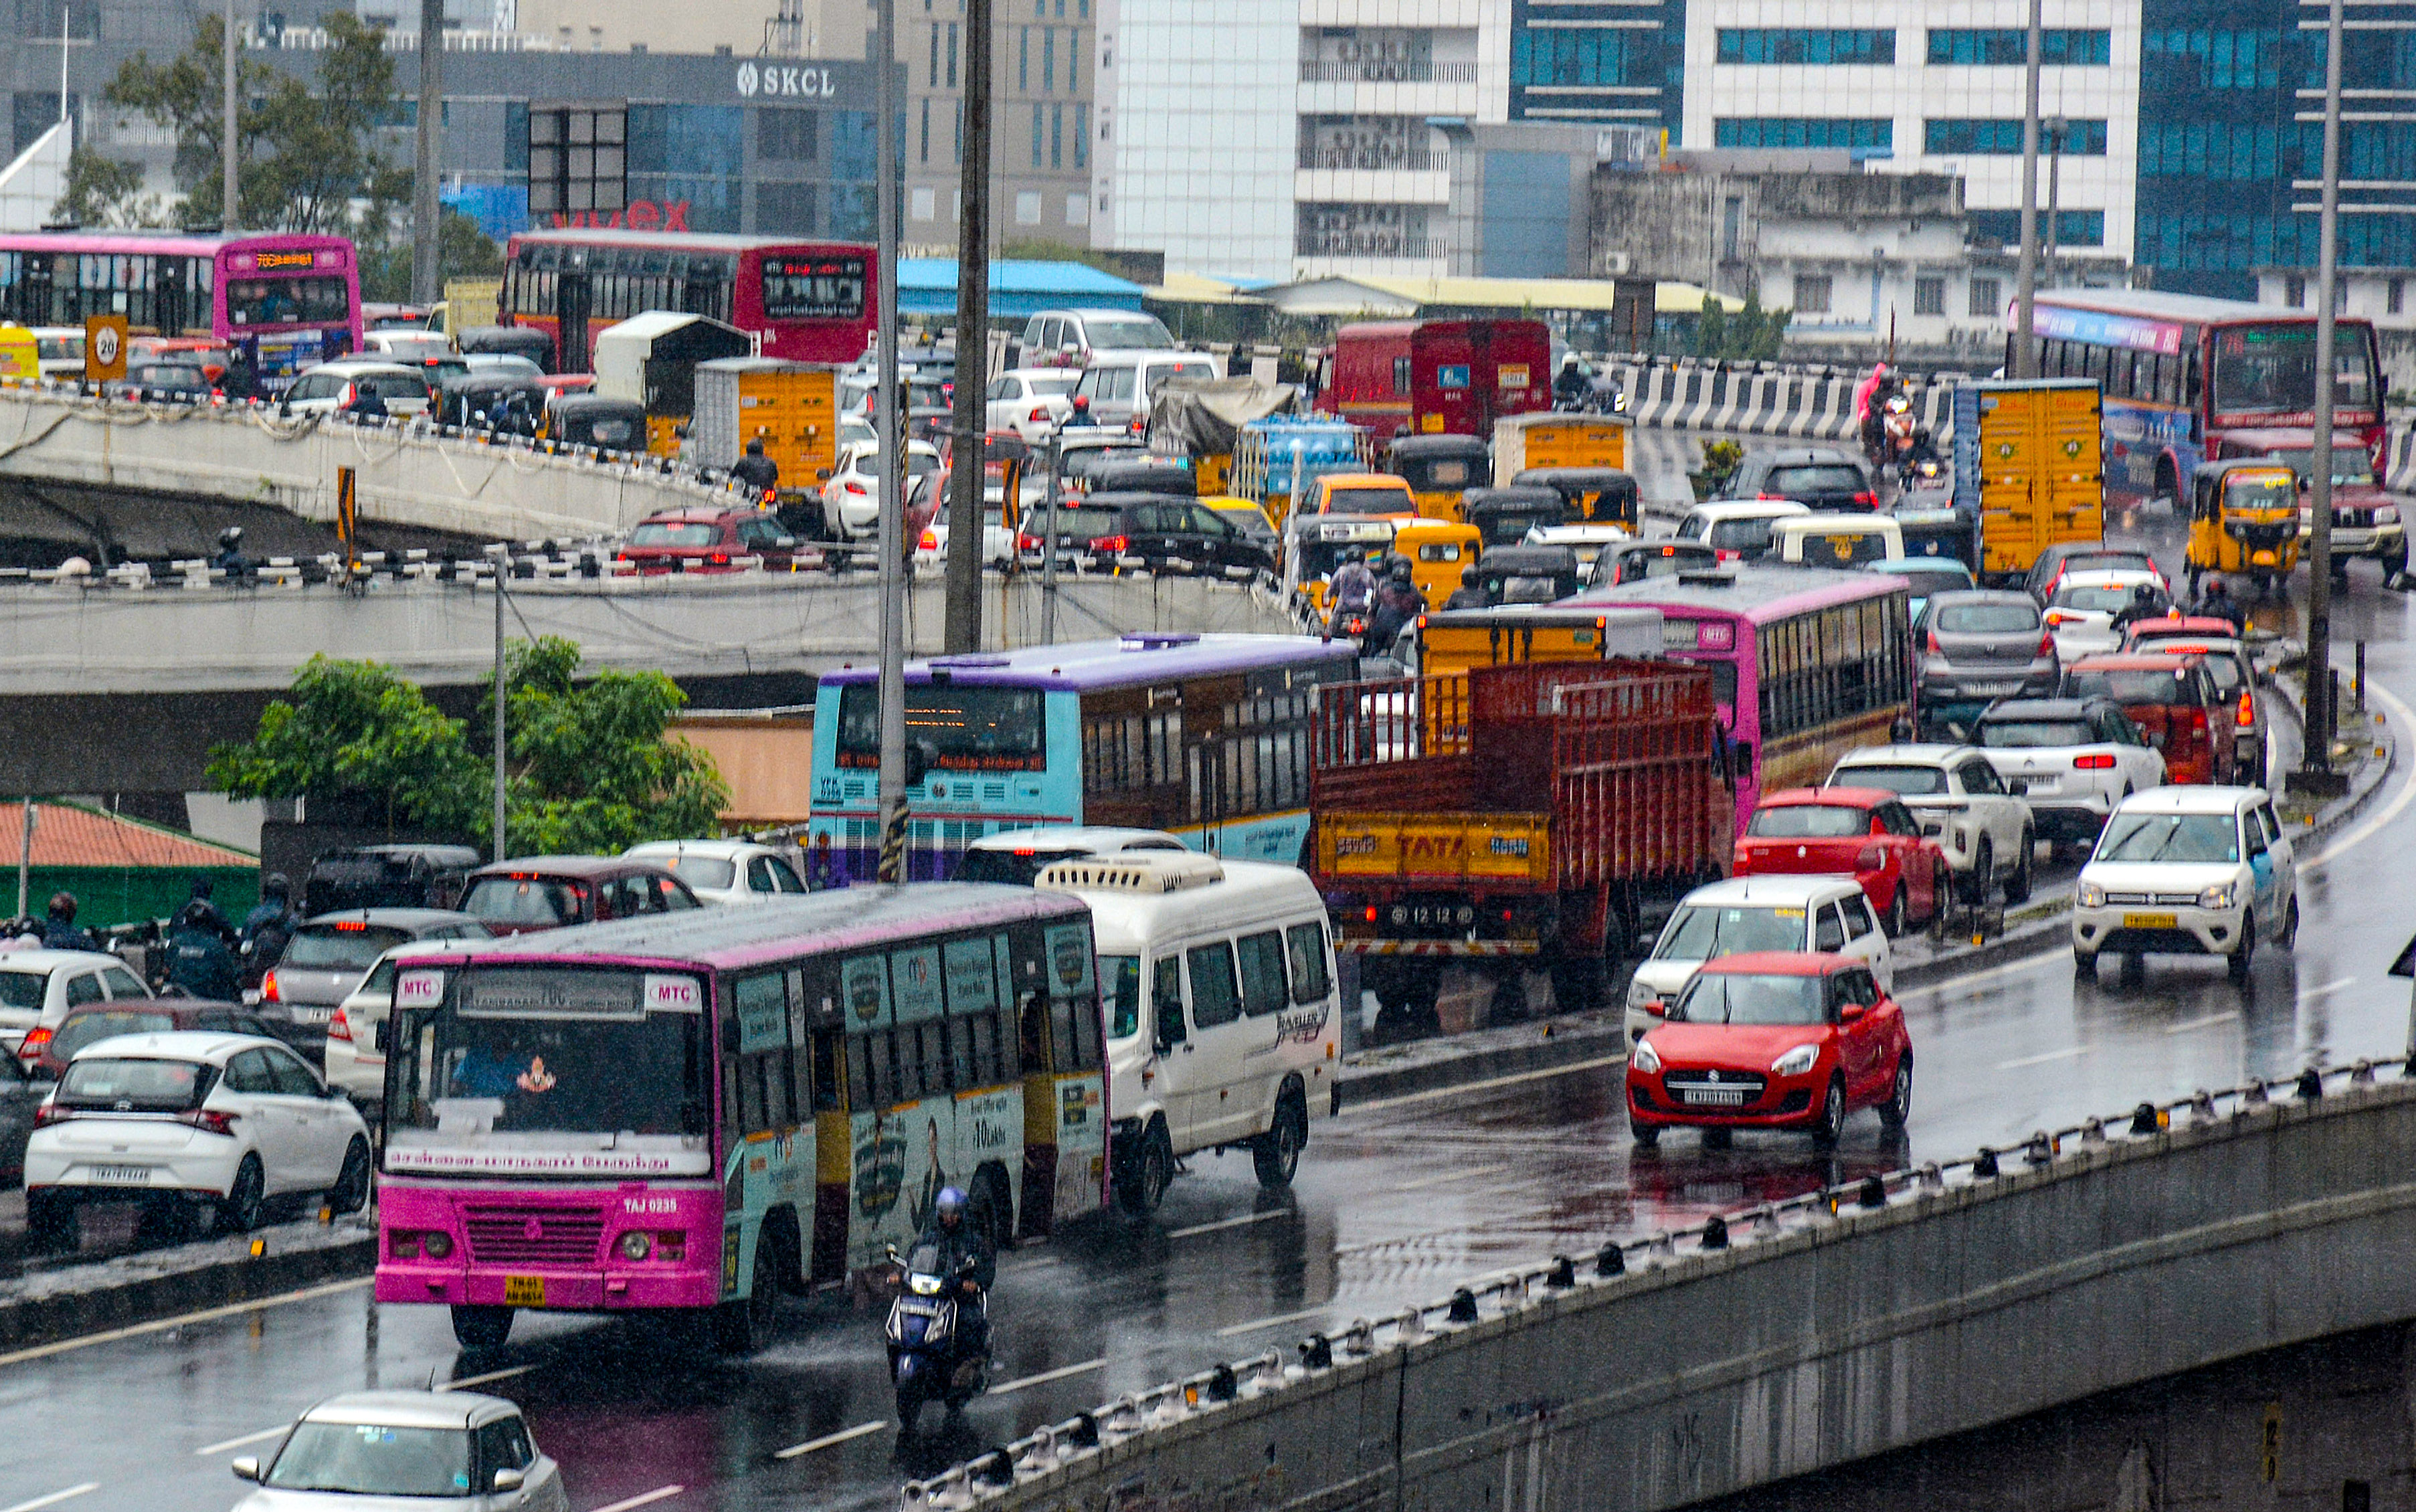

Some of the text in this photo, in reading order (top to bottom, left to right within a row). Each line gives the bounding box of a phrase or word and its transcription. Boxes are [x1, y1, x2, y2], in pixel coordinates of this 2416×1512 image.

[765, 66, 834, 98] SKCL
[100, 339, 114, 355] 20
[404, 980, 432, 996] MTC
[658, 985, 690, 1002] MTC
[624, 1198, 646, 1213] TAJ
